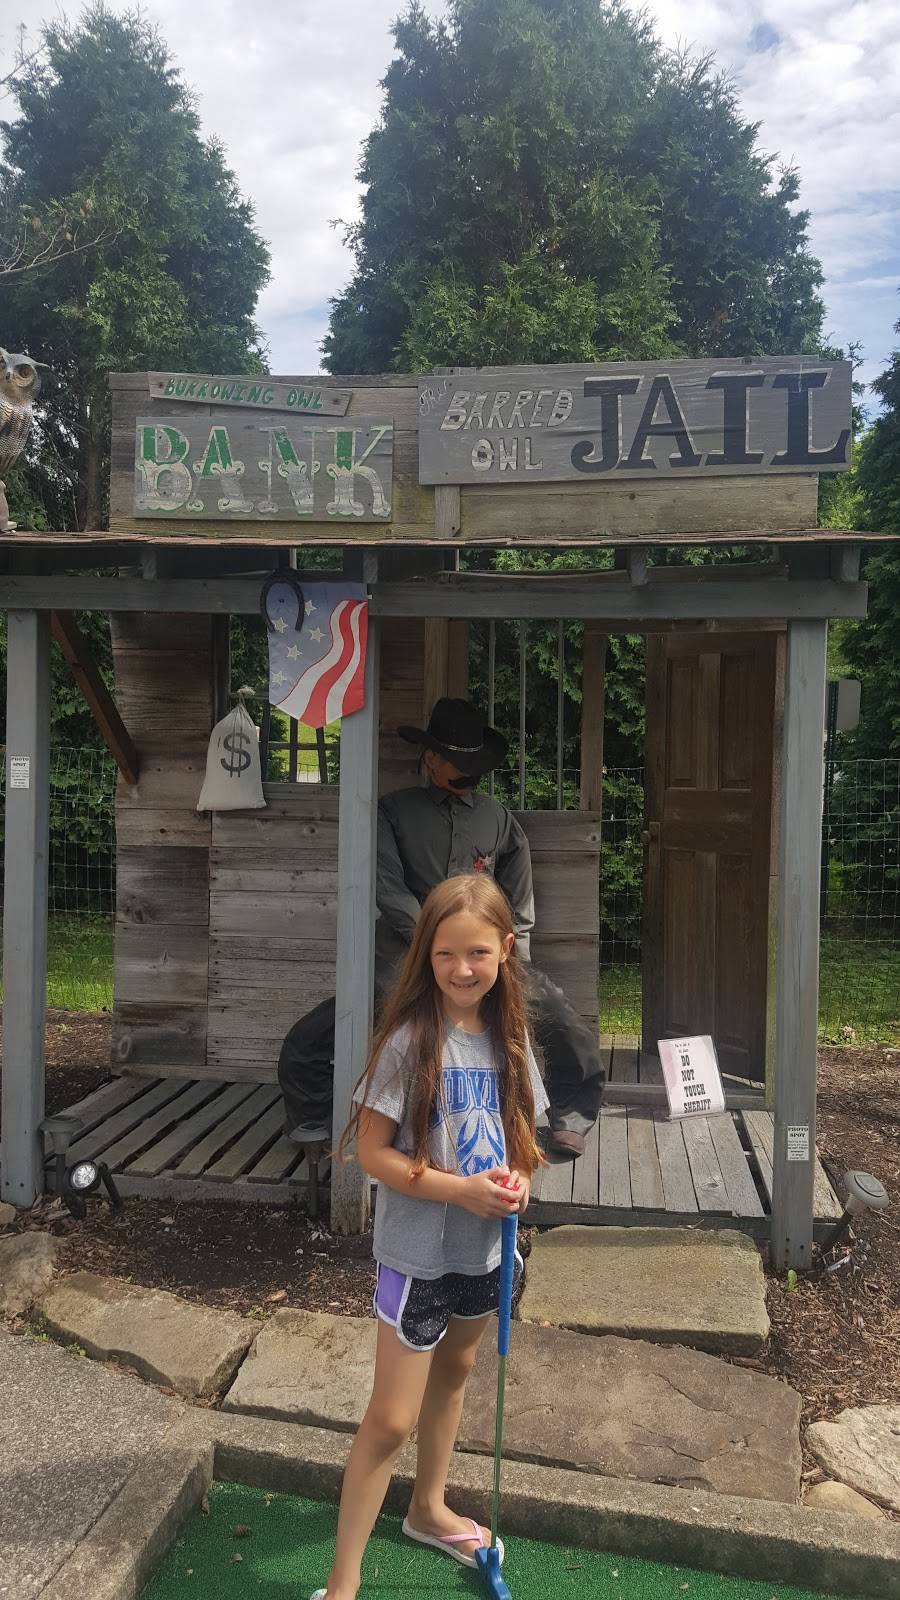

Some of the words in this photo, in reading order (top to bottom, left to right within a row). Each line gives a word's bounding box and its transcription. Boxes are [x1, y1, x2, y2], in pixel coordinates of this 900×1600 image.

[163, 378, 274, 405] BURROWING
[287, 389, 322, 409] OWL
[440, 390, 573, 431] BARRED
[571, 368, 850, 473] JAIL
[471, 437, 543, 471] OWL
[136, 424, 393, 517] BANK
[681, 1055, 690, 1066] DO
[681, 1069, 695, 1082] NOT
[683, 1099, 711, 1113] SHERIFF
[684, 1084, 706, 1097] TOUCH
